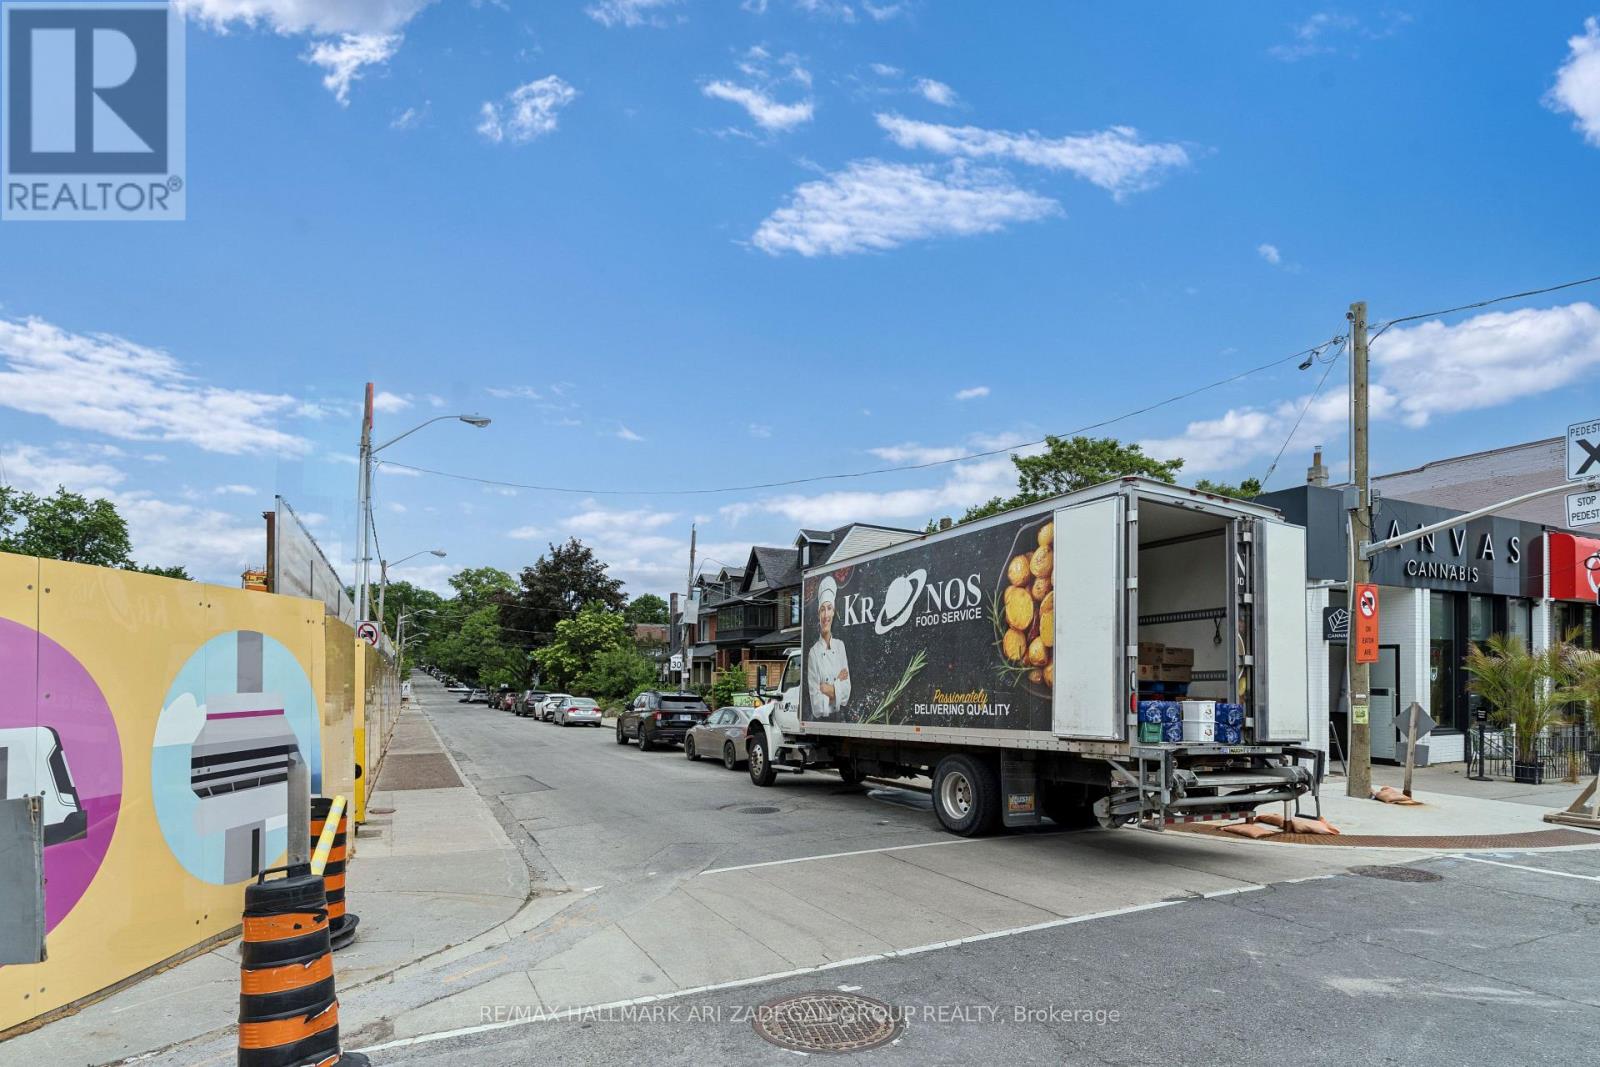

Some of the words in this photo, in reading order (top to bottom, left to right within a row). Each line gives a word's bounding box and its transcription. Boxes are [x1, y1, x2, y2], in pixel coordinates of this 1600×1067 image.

[1577, 495, 1597, 507] STOP
[1571, 508, 1600, 521] PEDEST
[1388, 519, 1521, 565] ANVAS
[1406, 559, 1480, 583] CANNABIS
[915, 614, 940, 628] FOOD
[941, 607, 982, 624] SERVICE
[671, 661, 682, 669] 30
[933, 688, 989, 710] Passionately
[914, 703, 965, 715] DELIVERING
[966, 703, 1010, 716] QUALITY
